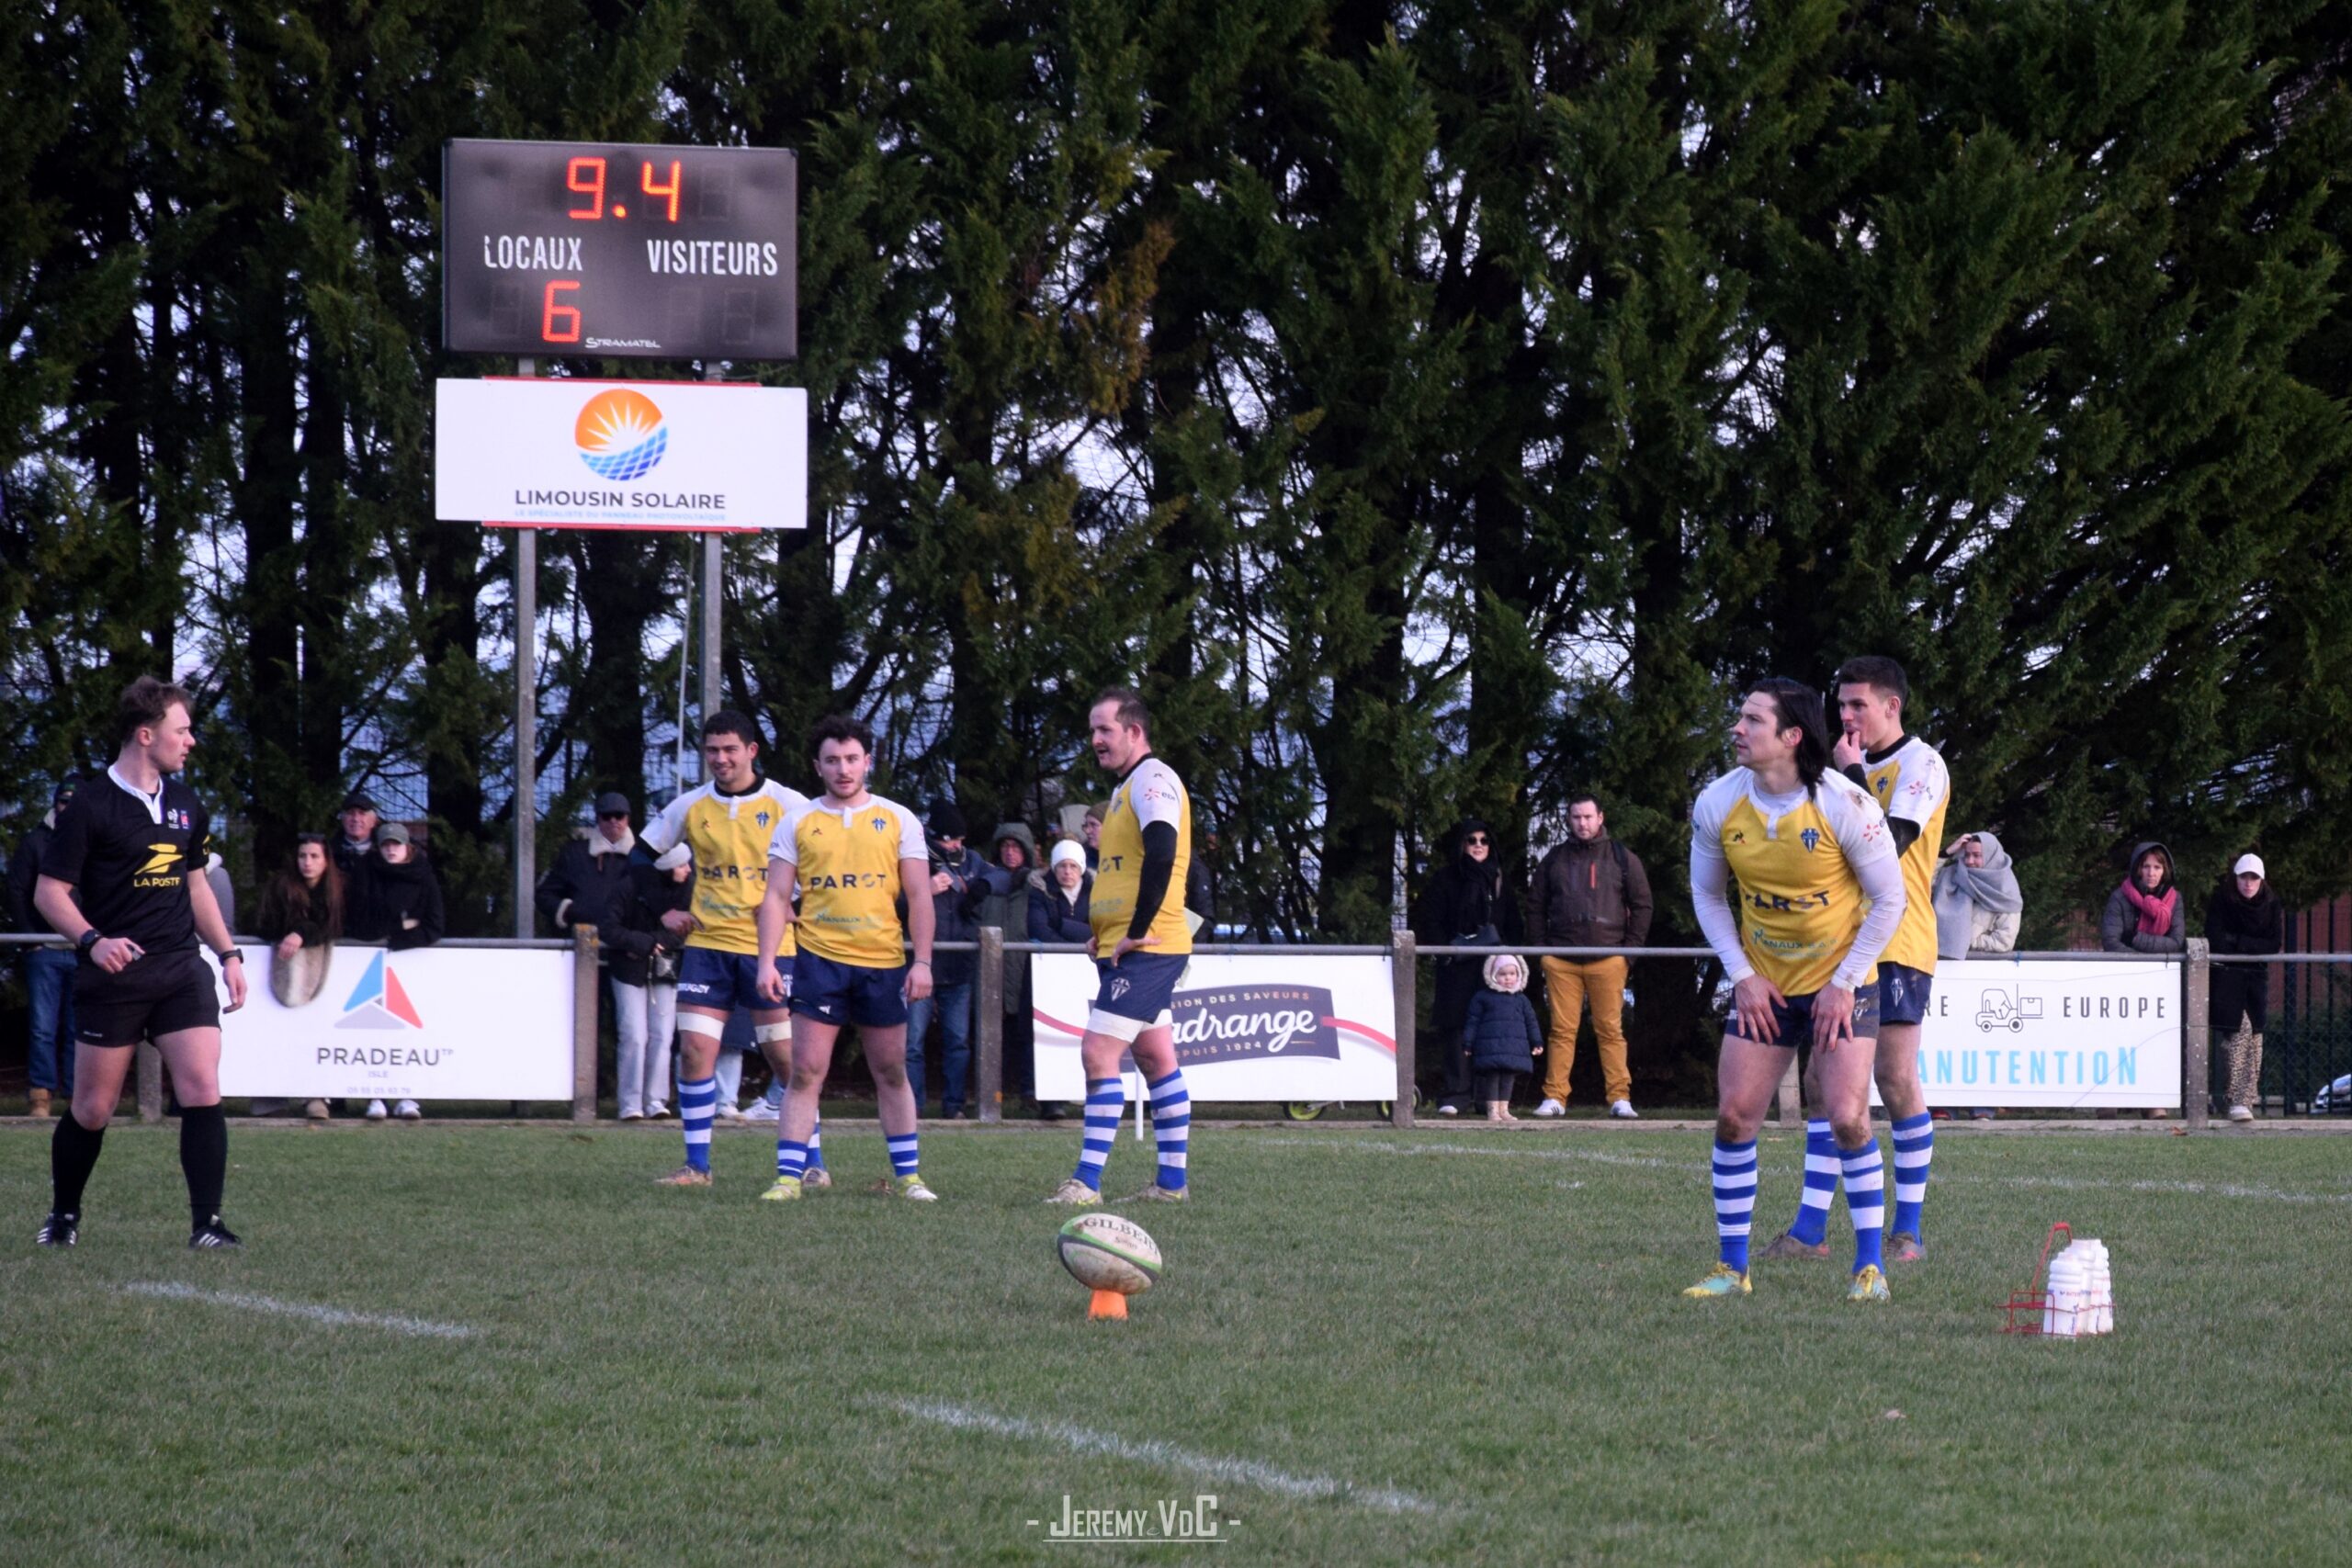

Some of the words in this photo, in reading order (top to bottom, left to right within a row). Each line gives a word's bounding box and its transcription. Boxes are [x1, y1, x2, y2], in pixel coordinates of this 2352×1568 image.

[484, 235, 583, 271] LOCAUX
[647, 239, 778, 276] VISITEURS
[542, 280, 581, 343] 6
[585, 336, 662, 348] STRAMATEL
[515, 490, 624, 507] LIMOUSIN
[631, 492, 726, 509] SOLAIRE
[134, 878, 151, 887] LA
[1170, 998, 1202, 1010] SION
[1209, 994, 1236, 1004] DES
[1244, 991, 1309, 1001] SAVEURS
[2064, 997, 2165, 1019] EUROPE
[1171, 1008, 1317, 1053] adrange
[317, 1047, 440, 1066] PRADEAU
[1917, 1046, 2136, 1085] ANUTENTION
